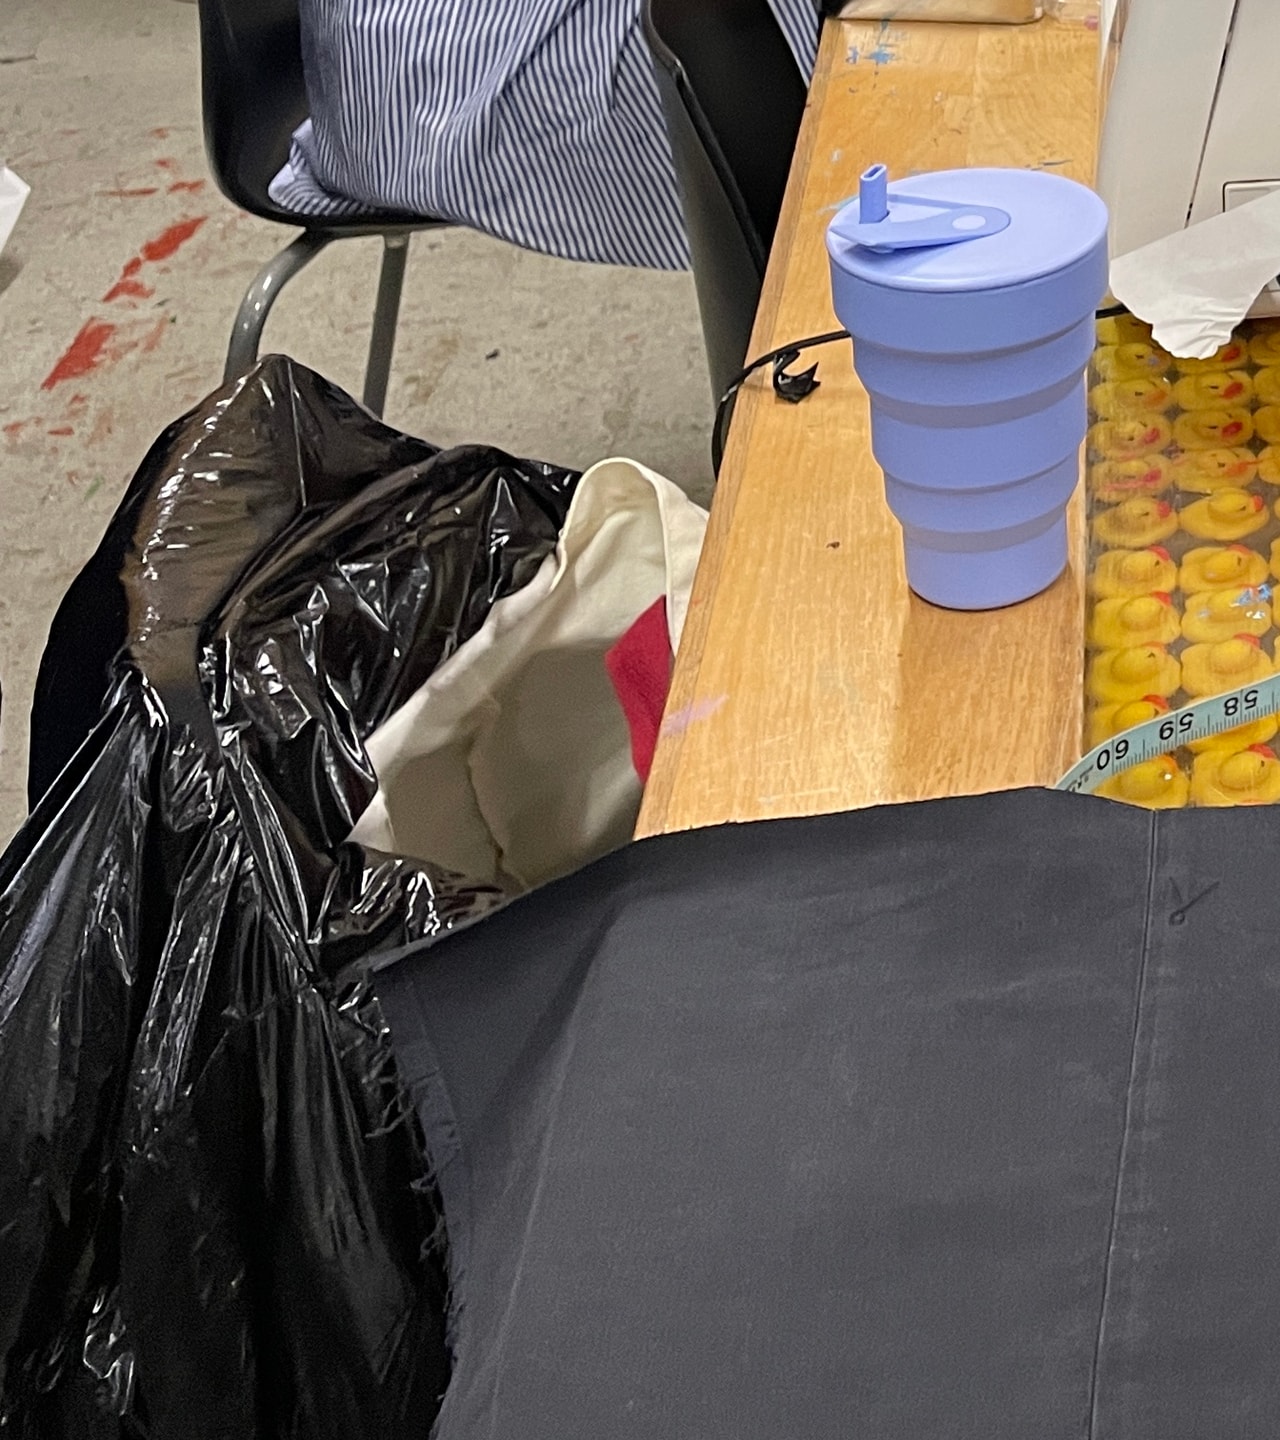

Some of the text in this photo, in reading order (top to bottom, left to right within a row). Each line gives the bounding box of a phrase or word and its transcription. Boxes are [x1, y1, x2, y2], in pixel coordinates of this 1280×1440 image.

[1224, 689, 1259, 716] 58
[1159, 712, 1195, 740] 59
[1095, 739, 1130, 770] 60
